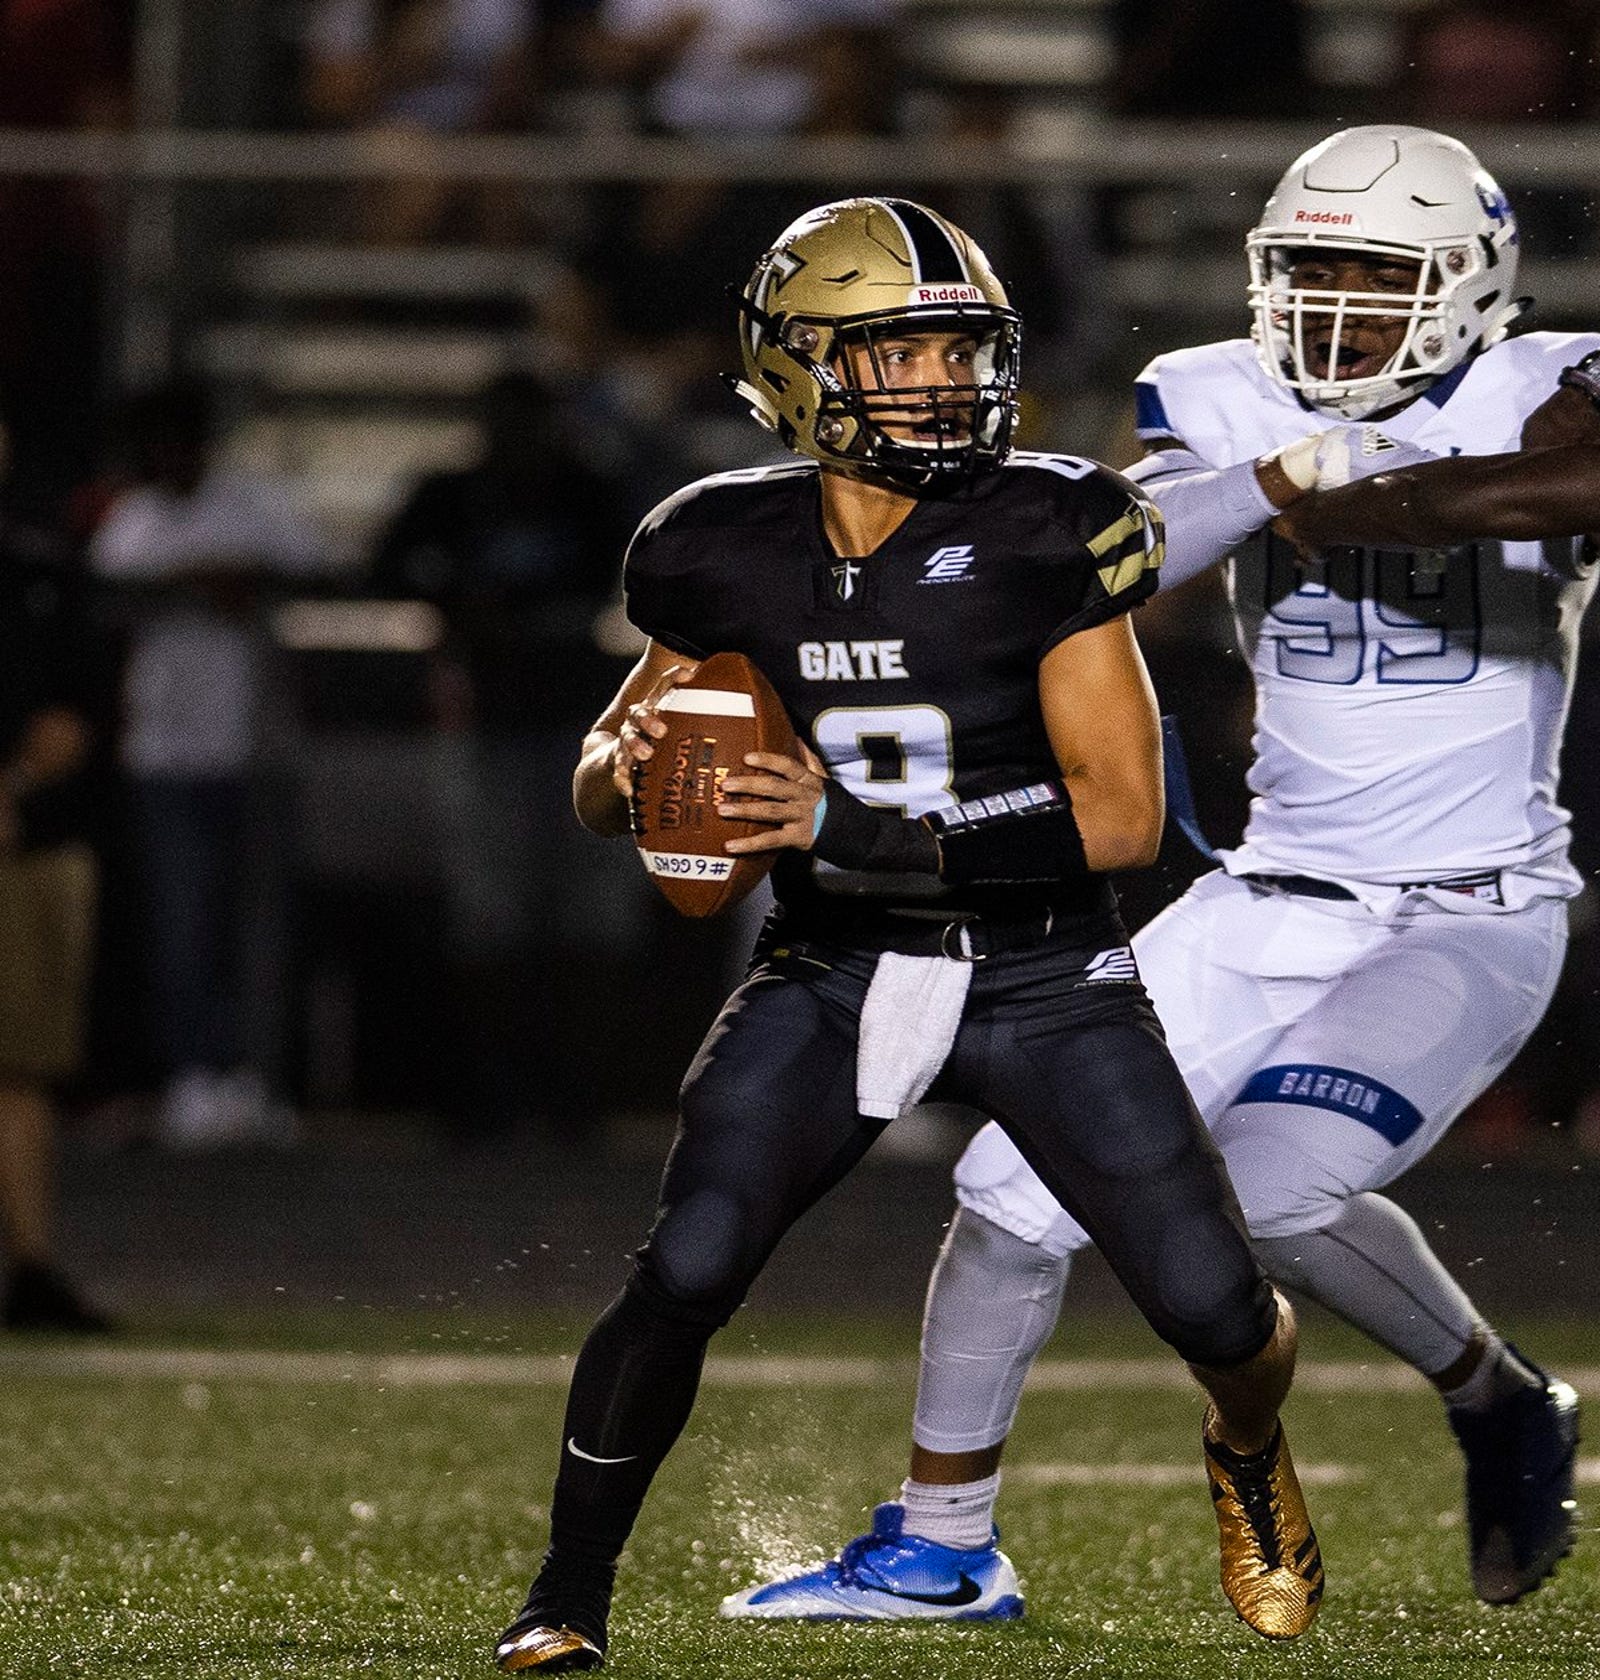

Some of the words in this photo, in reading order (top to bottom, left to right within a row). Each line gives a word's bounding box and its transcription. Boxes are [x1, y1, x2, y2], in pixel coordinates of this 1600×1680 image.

[1295, 210, 1353, 225] Riddell
[919, 288, 978, 302] Riddell
[1264, 543, 1479, 686] 99
[798, 639, 911, 682] GATE
[1277, 1071, 1382, 1115] BARRON
